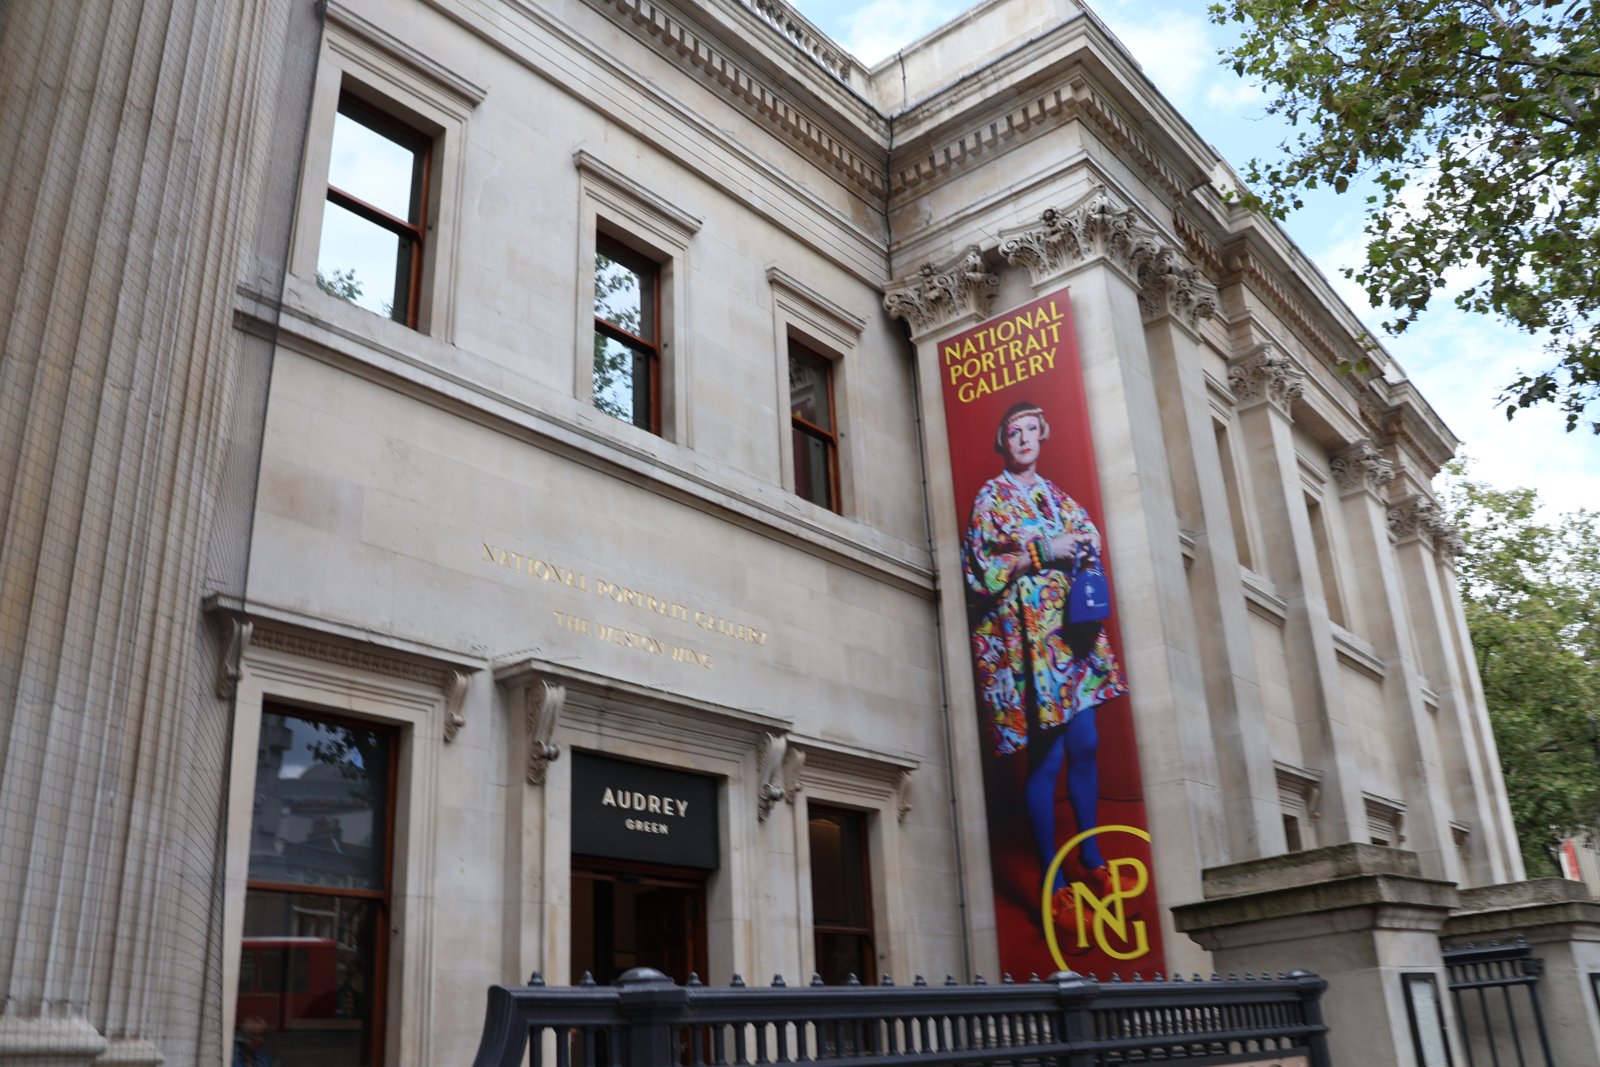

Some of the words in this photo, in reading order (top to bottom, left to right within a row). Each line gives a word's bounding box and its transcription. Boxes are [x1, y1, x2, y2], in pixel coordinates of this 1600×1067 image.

[944, 301, 1064, 365] NATIONAL
[950, 322, 1062, 385] PORTRAIT
[958, 347, 1057, 403] GALLERY
[482, 543, 591, 593] NATIONAL
[597, 578, 688, 623] PORTRAIT
[694, 610, 767, 646] GALLERY
[553, 610, 591, 636] THE
[597, 622, 664, 655] WESTON
[602, 786, 689, 818] AUDREY
[625, 818, 669, 835] GREEN
